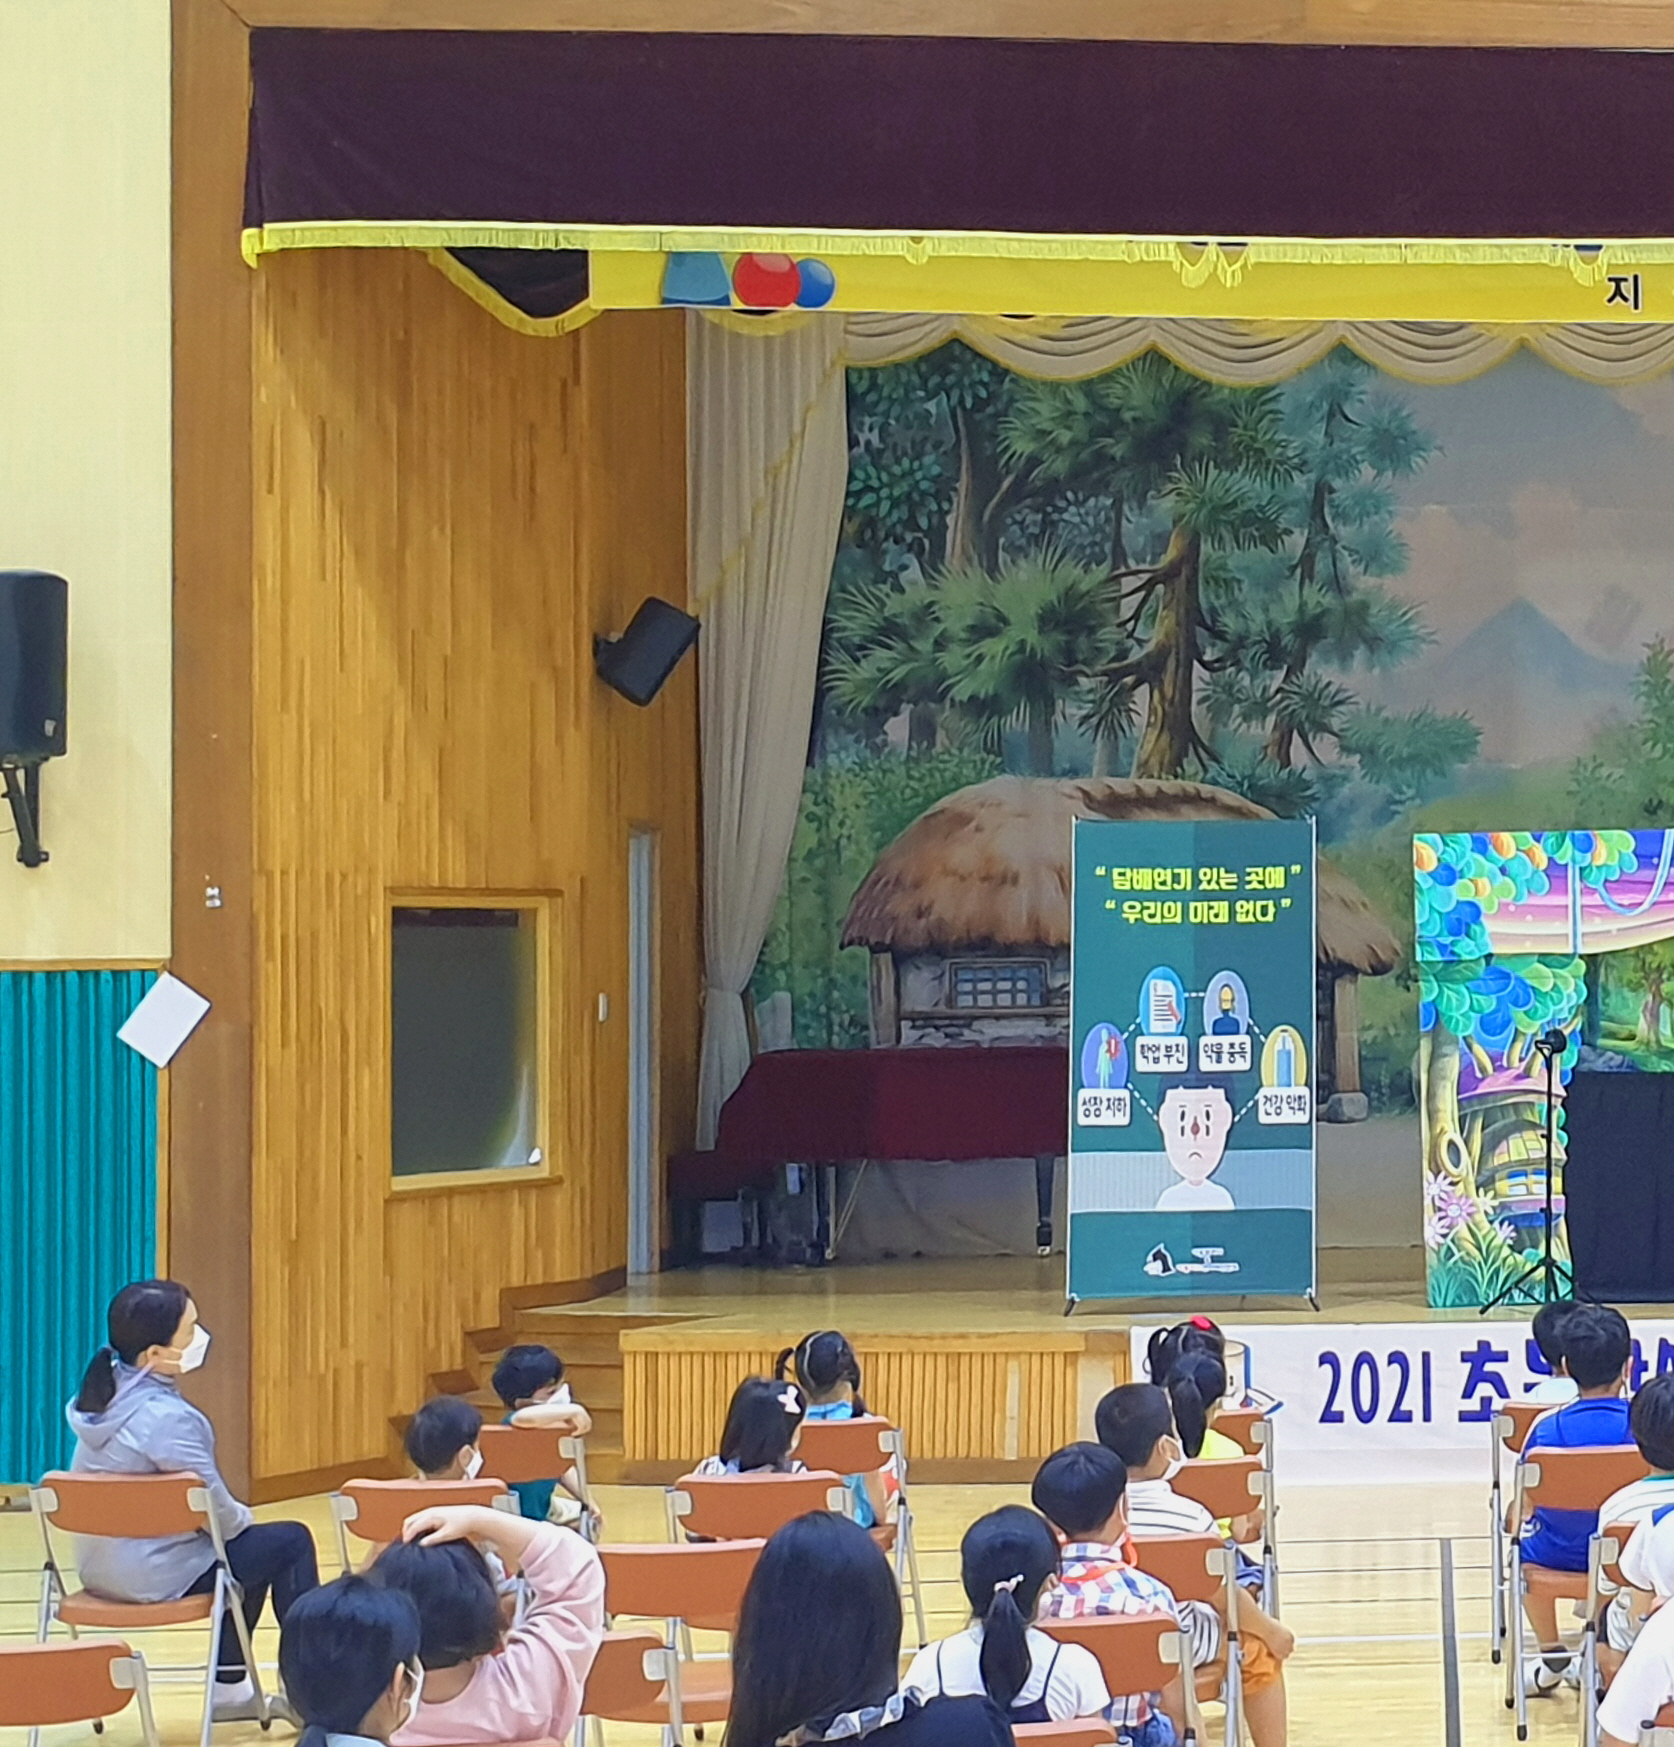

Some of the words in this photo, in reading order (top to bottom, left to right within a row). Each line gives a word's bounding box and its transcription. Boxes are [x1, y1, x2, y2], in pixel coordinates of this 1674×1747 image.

[1198, 866, 1239, 891] 있는
[1188, 900, 1230, 924] 미래
[1140, 1043, 1160, 1065] 학업
[1163, 1043, 1185, 1065] 부진
[1082, 1096, 1103, 1118] 성장
[1105, 1096, 1127, 1118] 저하
[1263, 1094, 1284, 1116] 건강
[1286, 1094, 1307, 1116] 악화
[1318, 1350, 1432, 1425] 2021
